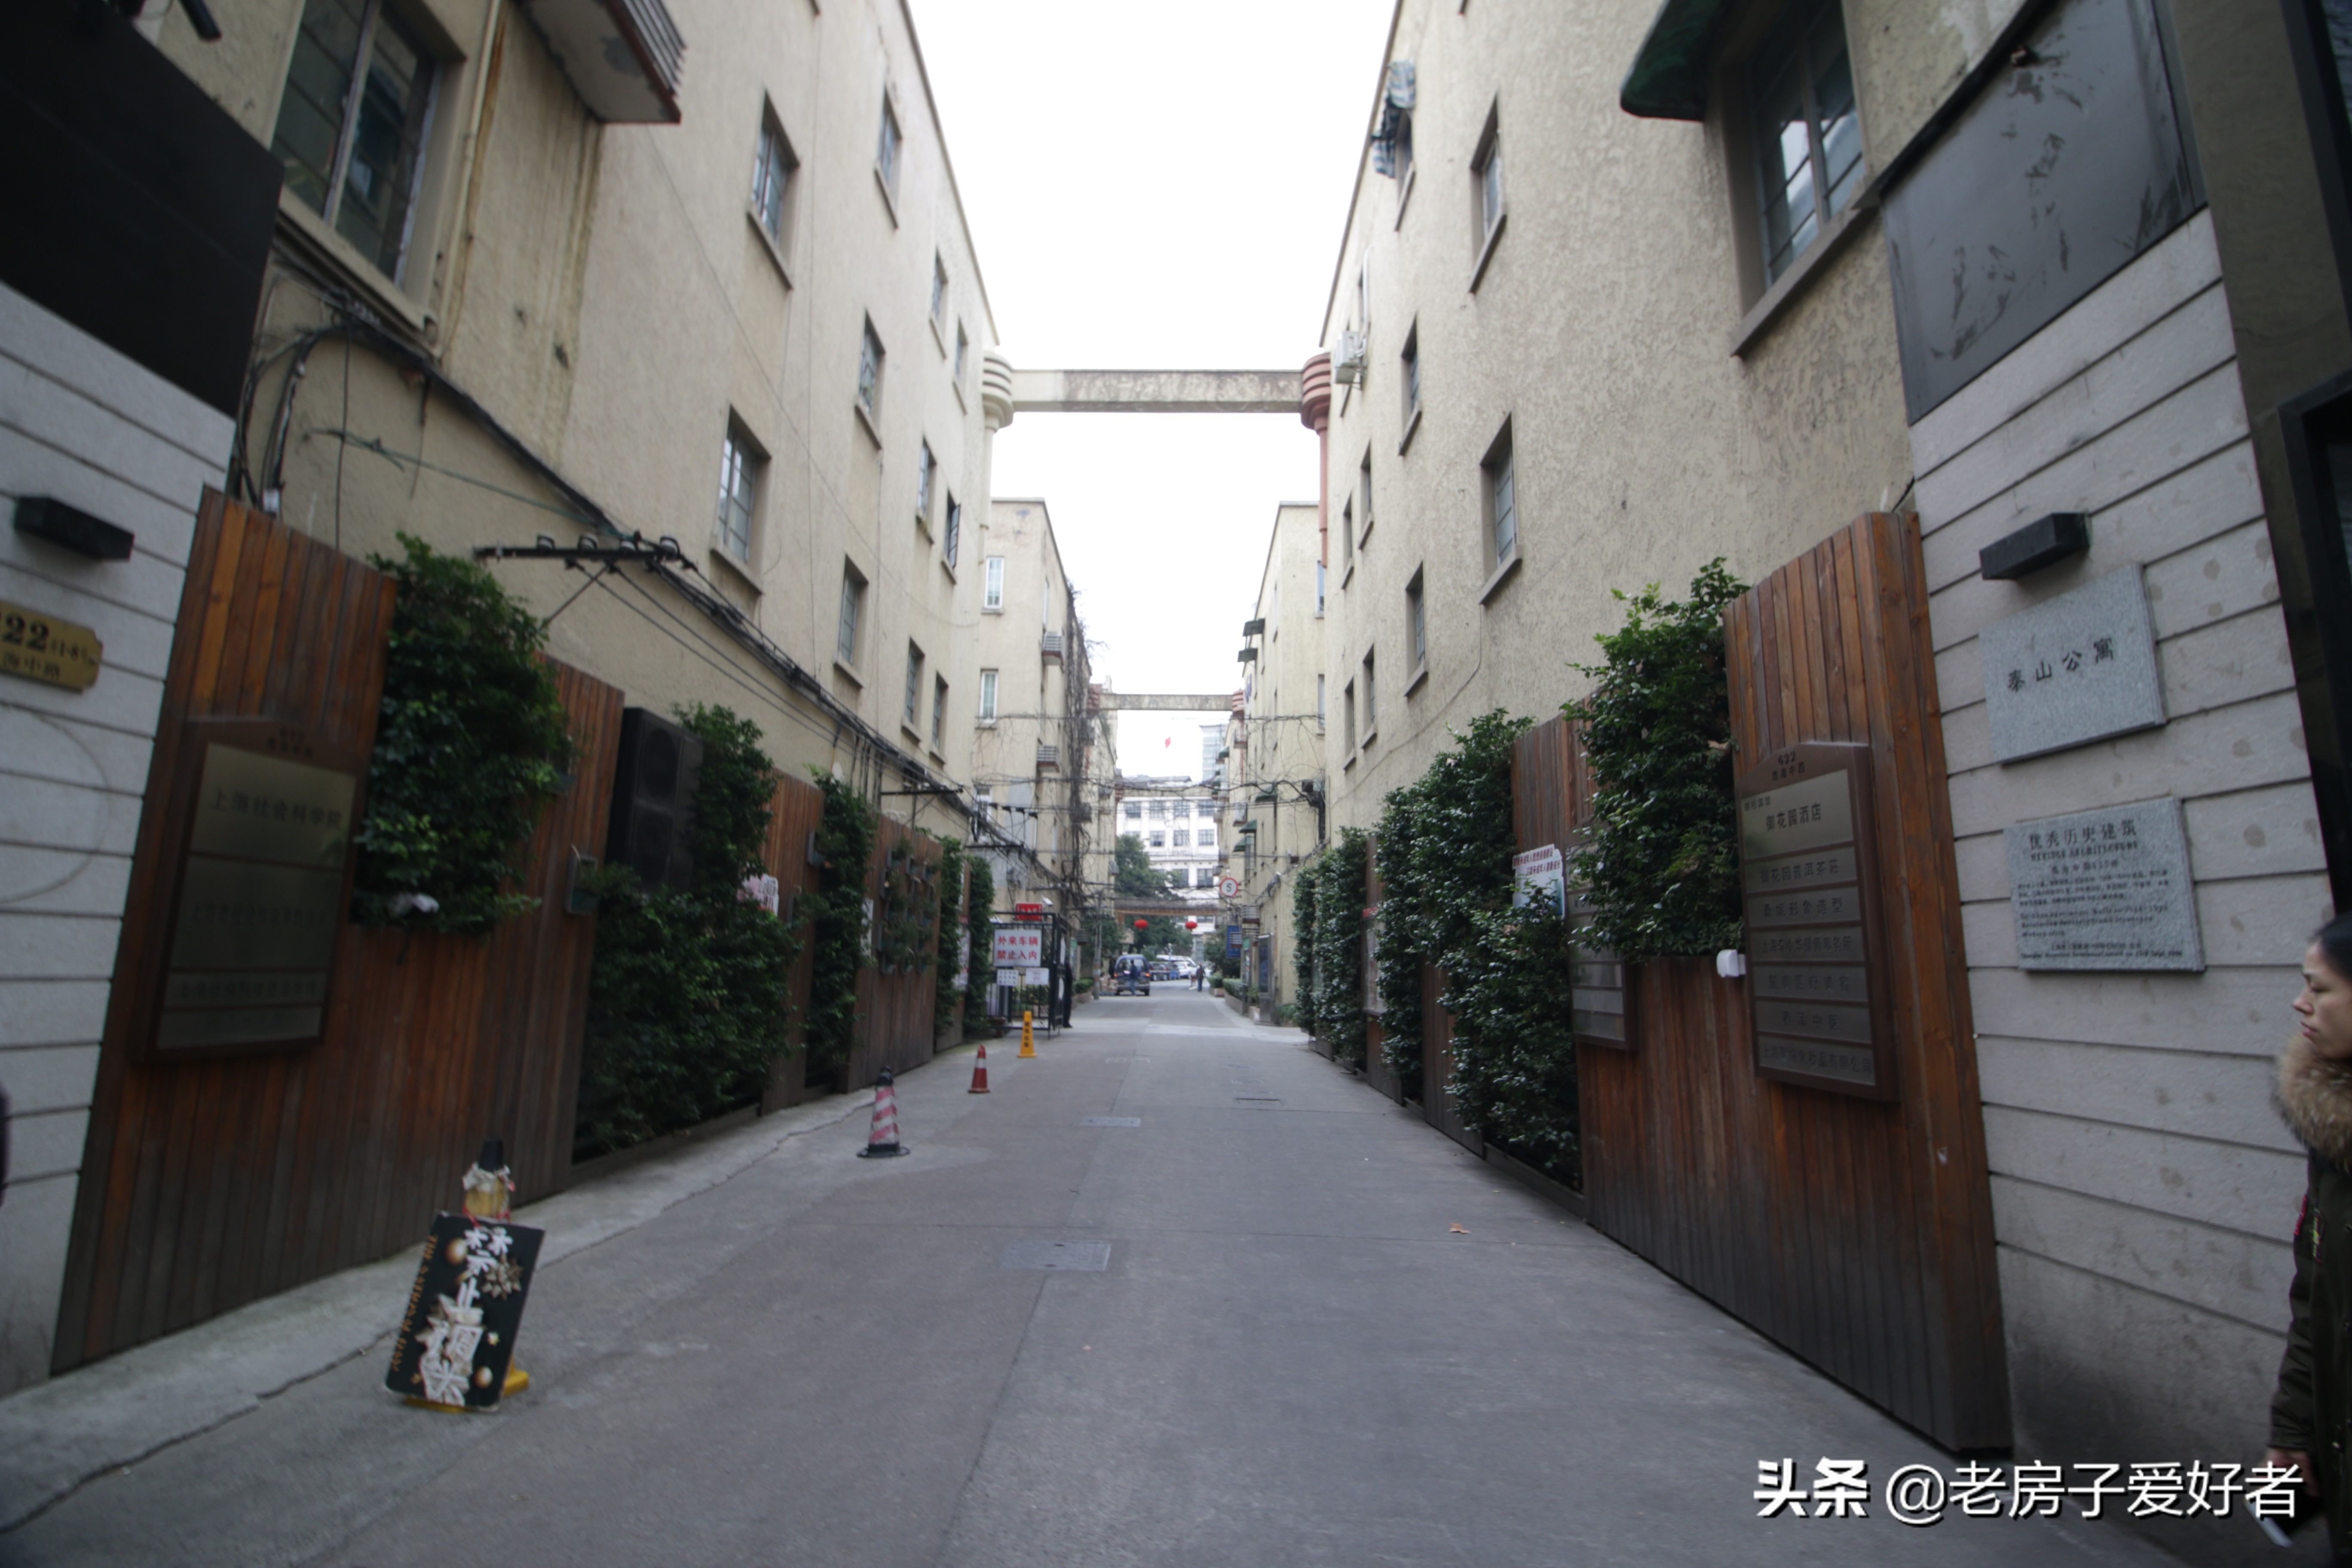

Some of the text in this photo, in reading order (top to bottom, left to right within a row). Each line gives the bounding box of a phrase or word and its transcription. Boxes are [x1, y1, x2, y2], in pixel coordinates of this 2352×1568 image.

[2008, 637, 2113, 692] 泰山公寓
[1778, 750, 1796, 765] 622
[209, 787, 344, 830] 上海社会科学院
[1766, 802, 1821, 832] 御花园酒店
[2029, 819, 2138, 850] 优秀历史建筑
[1226, 883, 1232, 892] 5
[998, 935, 1039, 946] 外来车辆
[997, 950, 1038, 960] 禁止入内
